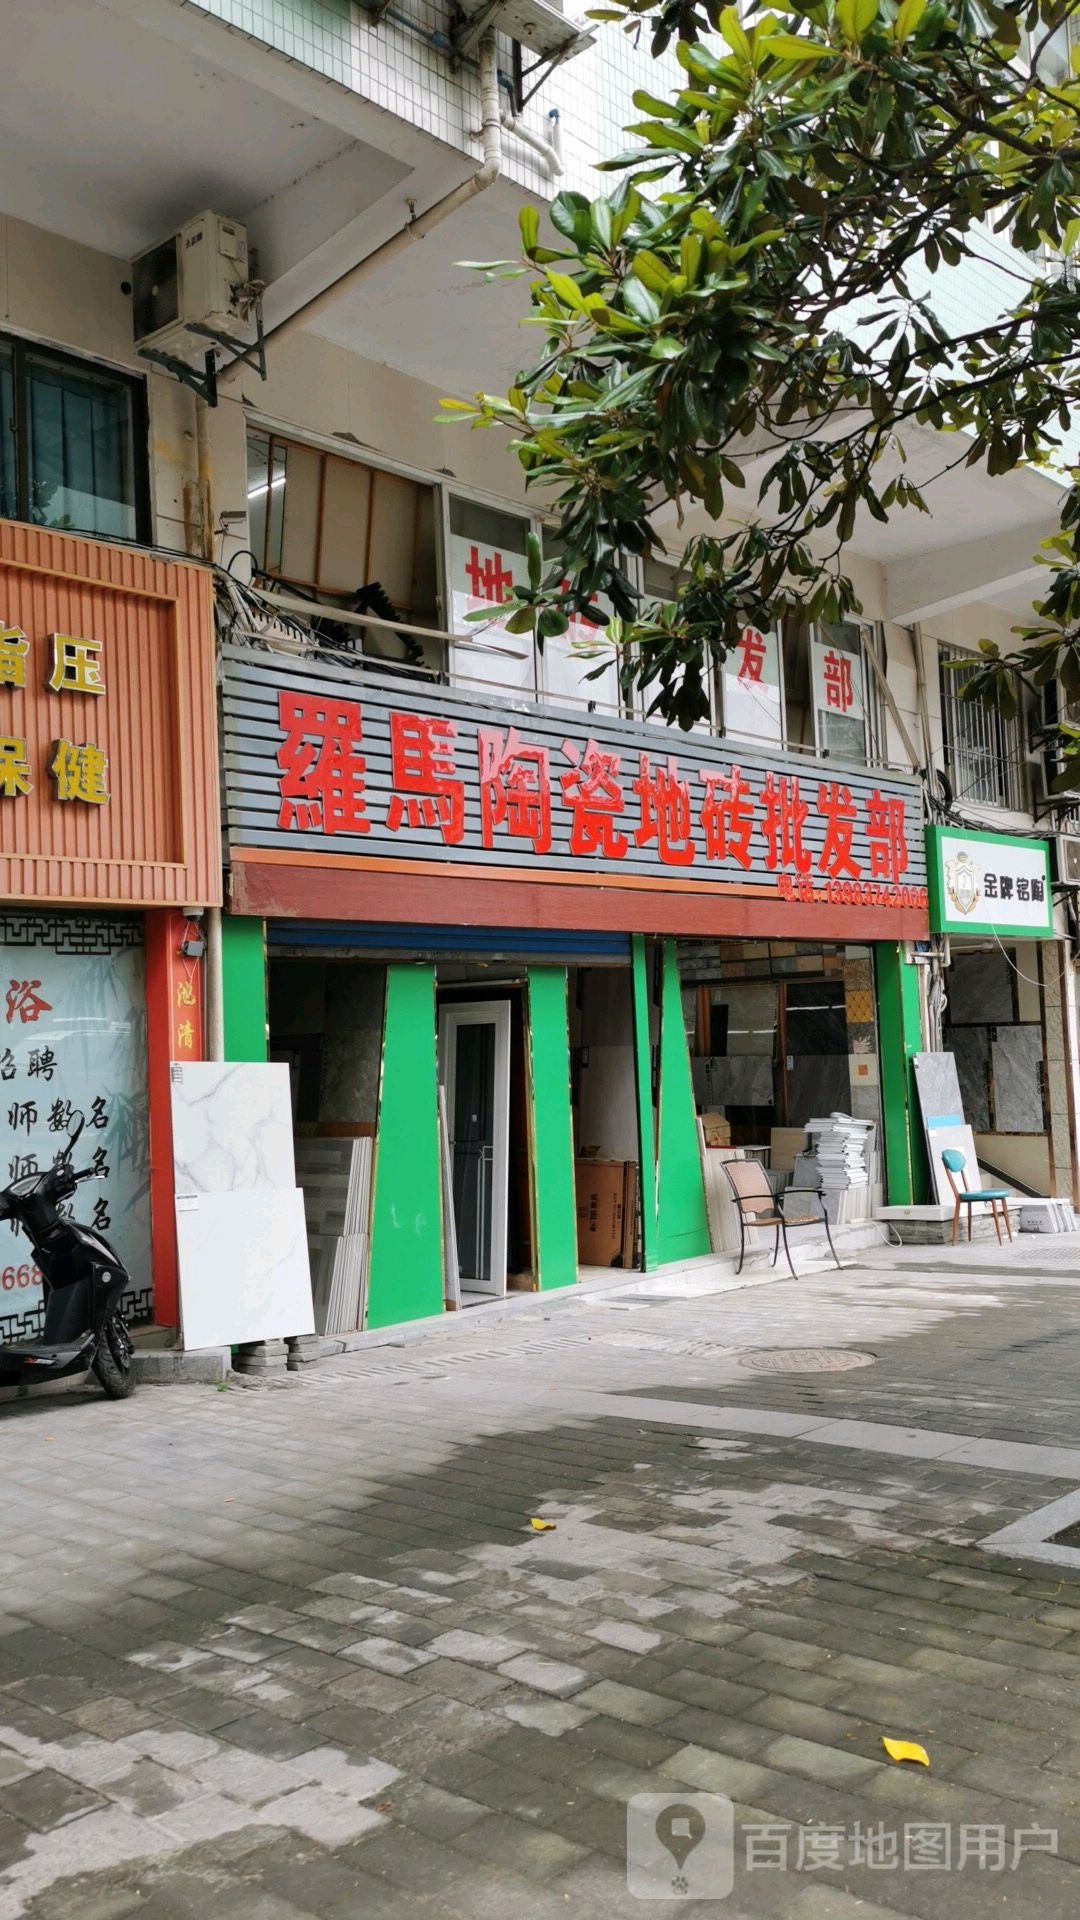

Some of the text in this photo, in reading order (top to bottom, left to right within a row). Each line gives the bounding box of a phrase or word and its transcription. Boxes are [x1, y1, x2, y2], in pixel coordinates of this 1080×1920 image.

[276, 690, 909, 884] 羅馬陶瓷地砖批发部
[5, 979, 53, 1025] 浴
